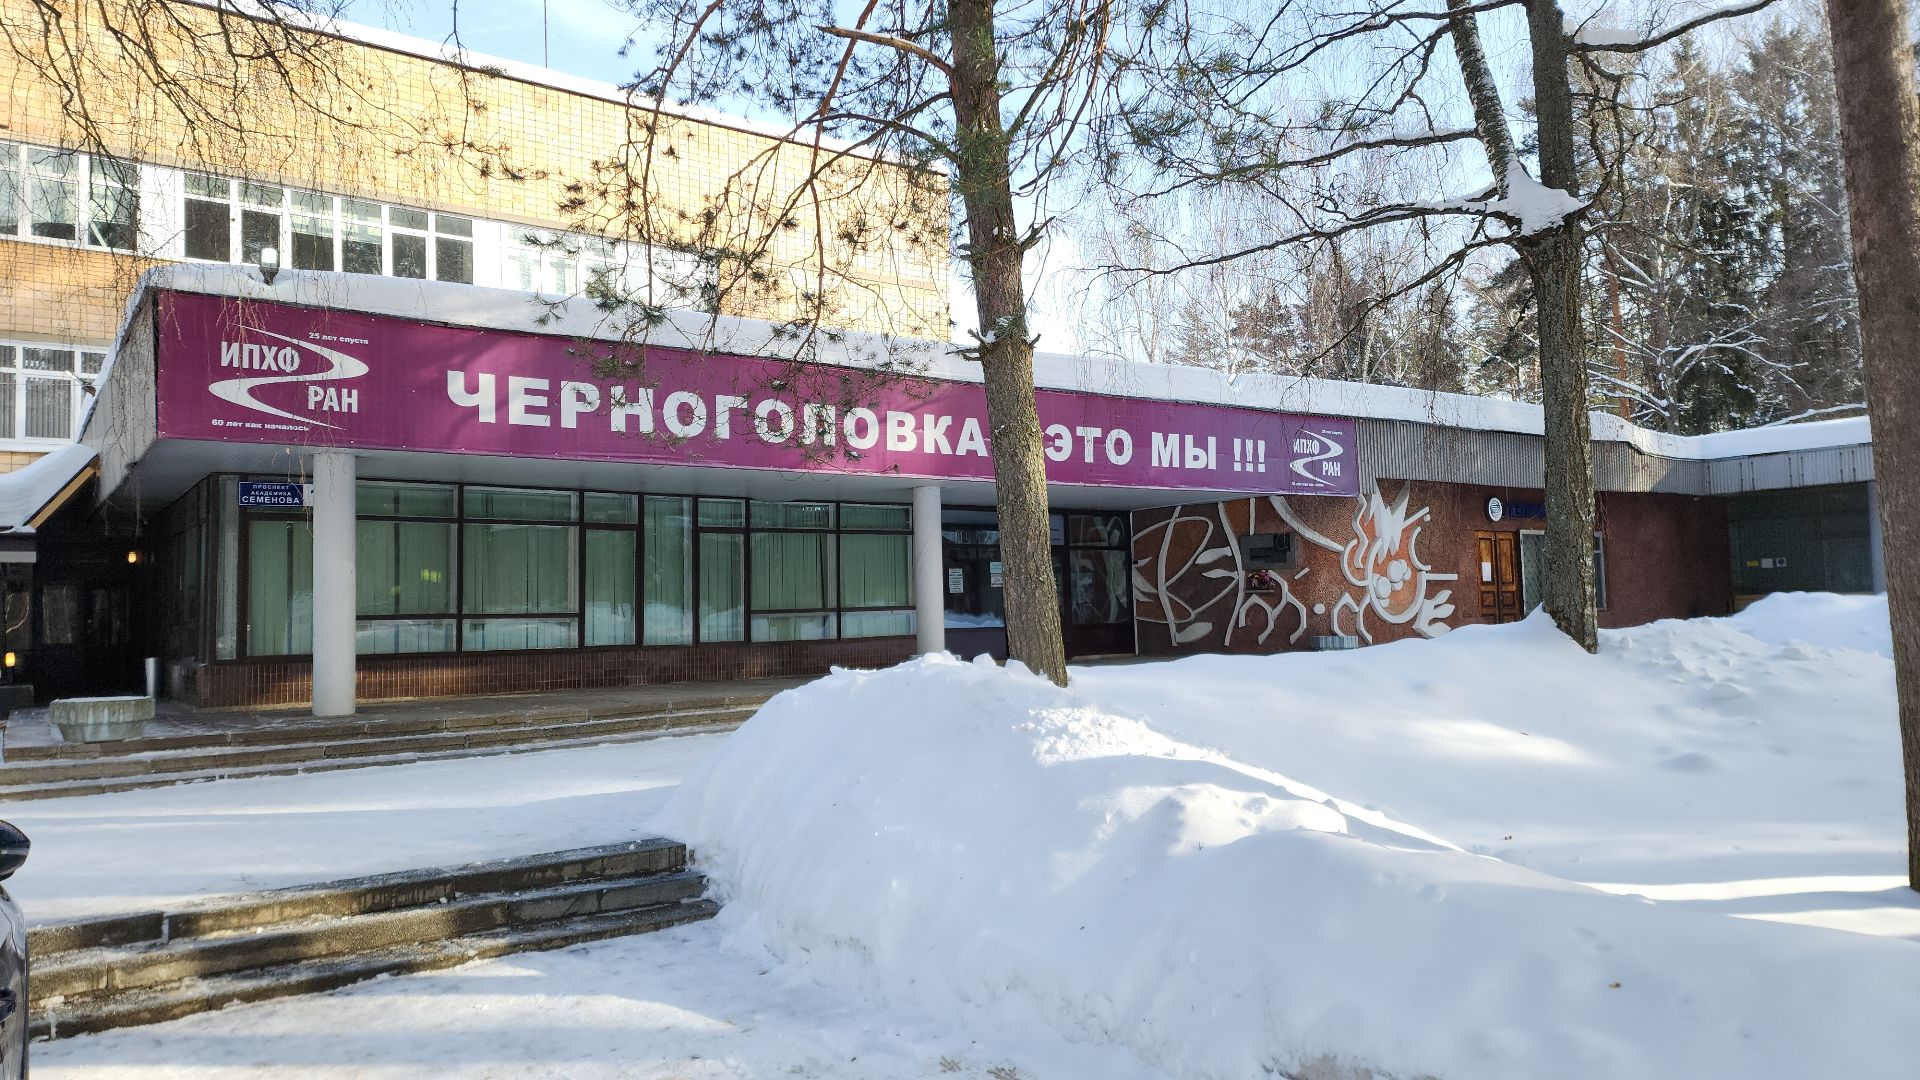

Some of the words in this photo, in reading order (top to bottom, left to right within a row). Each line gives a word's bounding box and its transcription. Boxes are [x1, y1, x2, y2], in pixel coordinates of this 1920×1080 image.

[308, 332, 320, 340] 25
[339, 336, 369, 345] спустя
[220, 341, 301, 373] ИПХФ
[307, 385, 359, 414] РАН
[264, 423, 309, 431] началось
[447, 370, 988, 457] ЧЕРНОГОЛОВКА
[1044, 424, 1133, 466] ЭТО
[1151, 431, 1217, 470] МЫ
[1233, 438, 1266, 473] !!!
[1293, 438, 1320, 455] ИПХФ
[1322, 461, 1341, 477] РАН
[241, 495, 300, 504] СЕМЕНОВА
